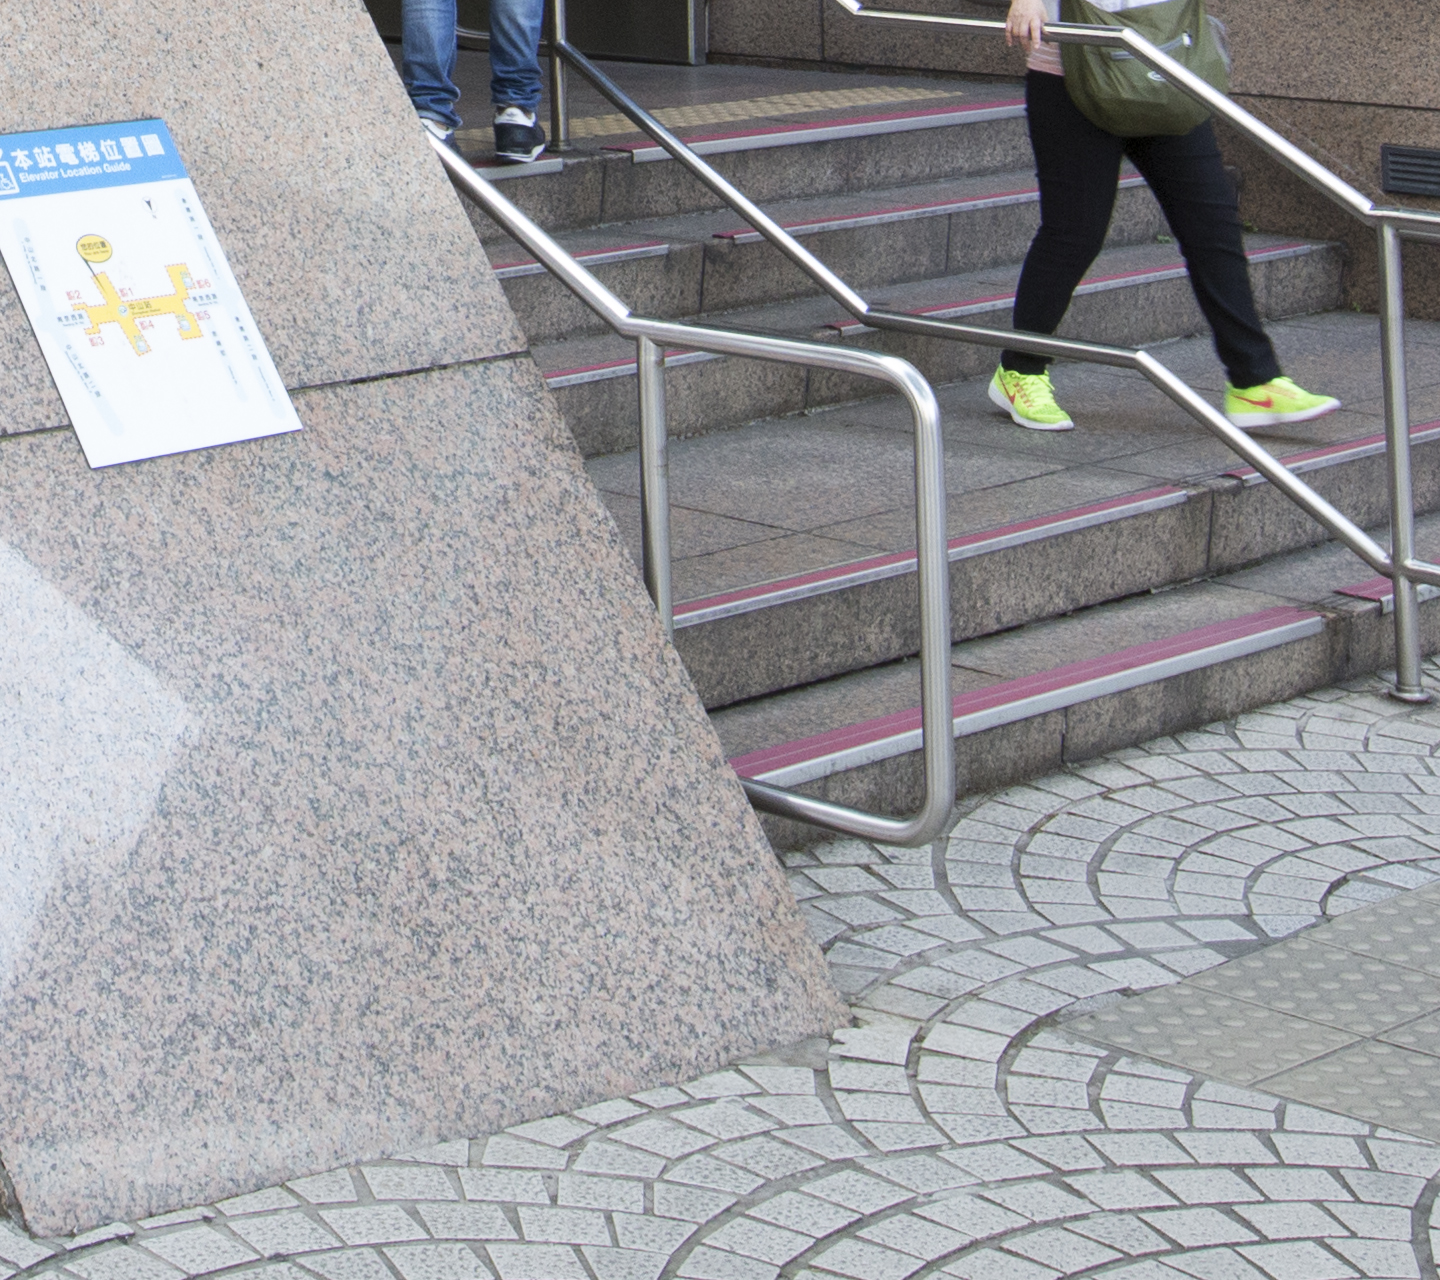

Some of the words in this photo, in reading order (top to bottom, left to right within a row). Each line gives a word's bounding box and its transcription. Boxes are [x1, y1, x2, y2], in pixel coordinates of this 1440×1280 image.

[10, 133, 165, 172] 本站電梯位置圖
[19, 169, 59, 184] Elevator
[60, 164, 102, 180] Location
[103, 161, 131, 174] Guide
